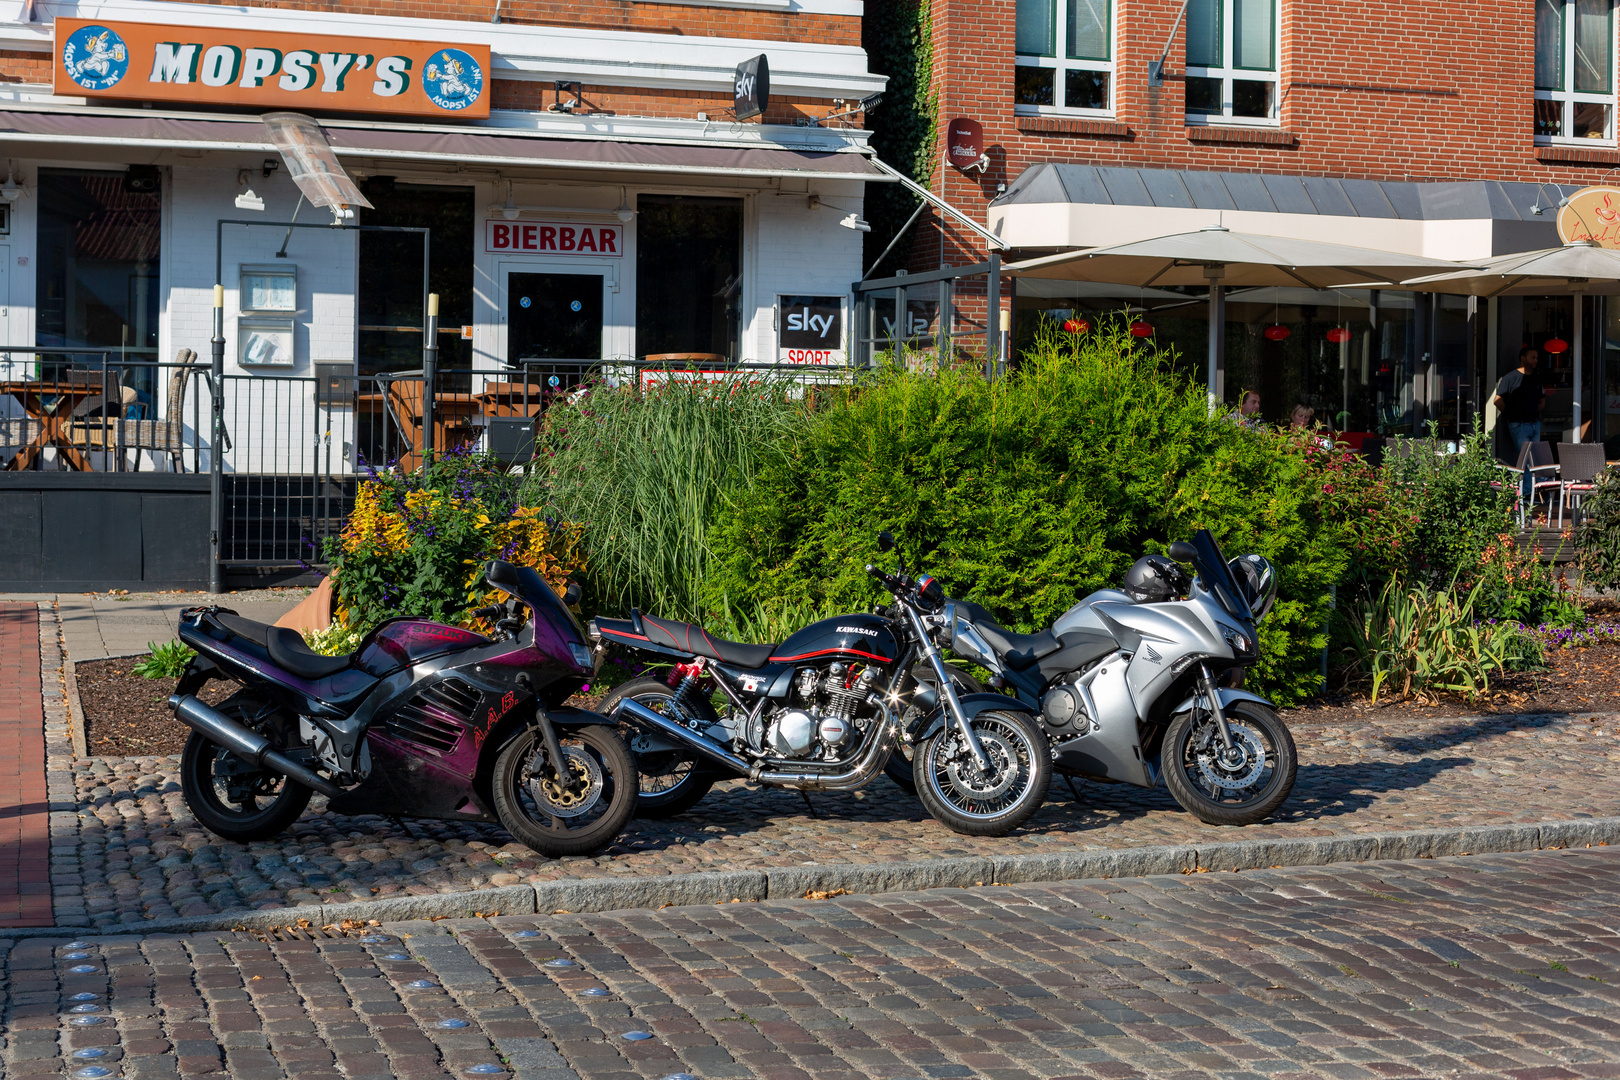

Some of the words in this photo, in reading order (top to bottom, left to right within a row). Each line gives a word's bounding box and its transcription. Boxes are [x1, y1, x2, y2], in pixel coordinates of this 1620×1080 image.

[64, 41, 81, 80] MOPSY
[80, 78, 98, 89] IST
[149, 42, 413, 98] MOPSY'S
[432, 95, 466, 109] MOPSY
[467, 87, 480, 102] IST
[735, 72, 755, 101] sky
[493, 224, 617, 253] BIERBAR
[787, 306, 835, 338] sky
[788, 349, 831, 366] SPORT
[412, 625, 467, 641] SUZUKI
[835, 626, 879, 637] KAWASAKI
[473, 690, 519, 749] A.A.B.
